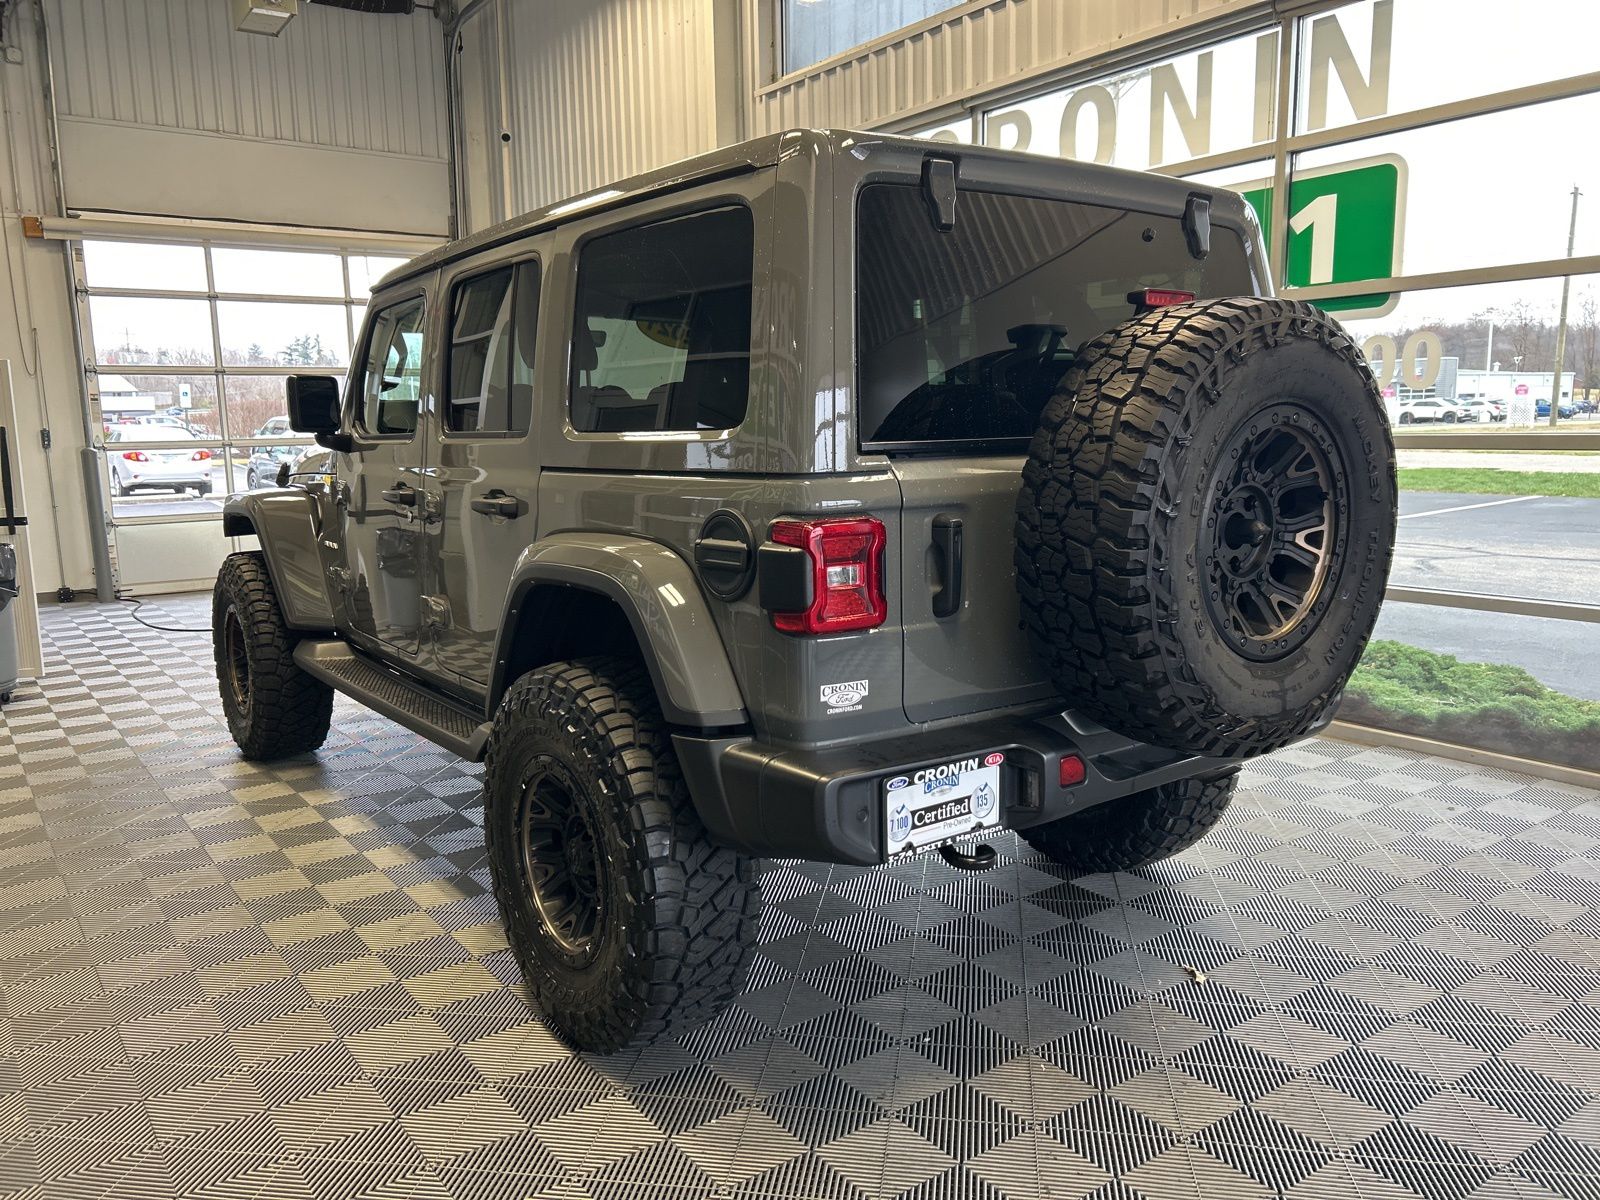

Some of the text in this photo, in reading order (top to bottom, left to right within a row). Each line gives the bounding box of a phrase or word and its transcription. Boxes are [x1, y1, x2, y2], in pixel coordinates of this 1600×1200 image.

[927, 0, 1393, 166] ONIN
[1289, 193, 1338, 285] 1
[1324, 527, 1380, 666] THOMPSON
[822, 681, 867, 697] CRONIN
[835, 693, 855, 704] Ford
[988, 755, 1001, 765] KIA
[913, 758, 979, 784] CRONIN
[925, 776, 959, 792] CRONIN
[976, 793, 989, 808] 135
[913, 799, 969, 826] Certified
[943, 816, 972, 829] Pre-Owned
[888, 825, 1003, 863] I-74 EXIT 1 Harrison
